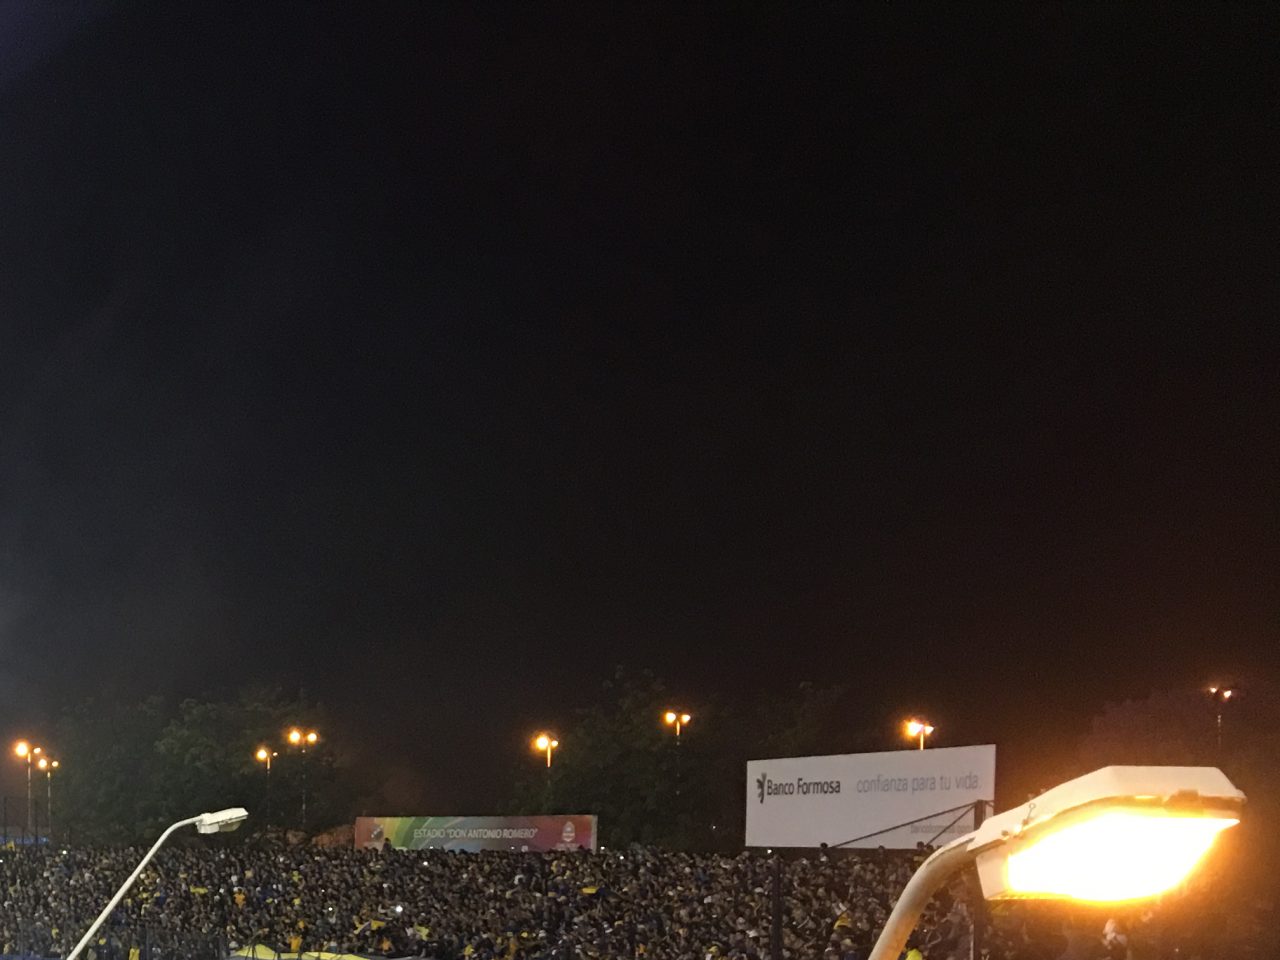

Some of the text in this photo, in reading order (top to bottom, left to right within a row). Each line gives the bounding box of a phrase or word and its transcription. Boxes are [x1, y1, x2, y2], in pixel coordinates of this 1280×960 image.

[766, 777, 841, 796] Banco Formosa
[856, 774, 908, 793] confianza
[911, 776, 936, 795] para
[939, 774, 951, 791] tu
[413, 828, 446, 839] ESTADIO
